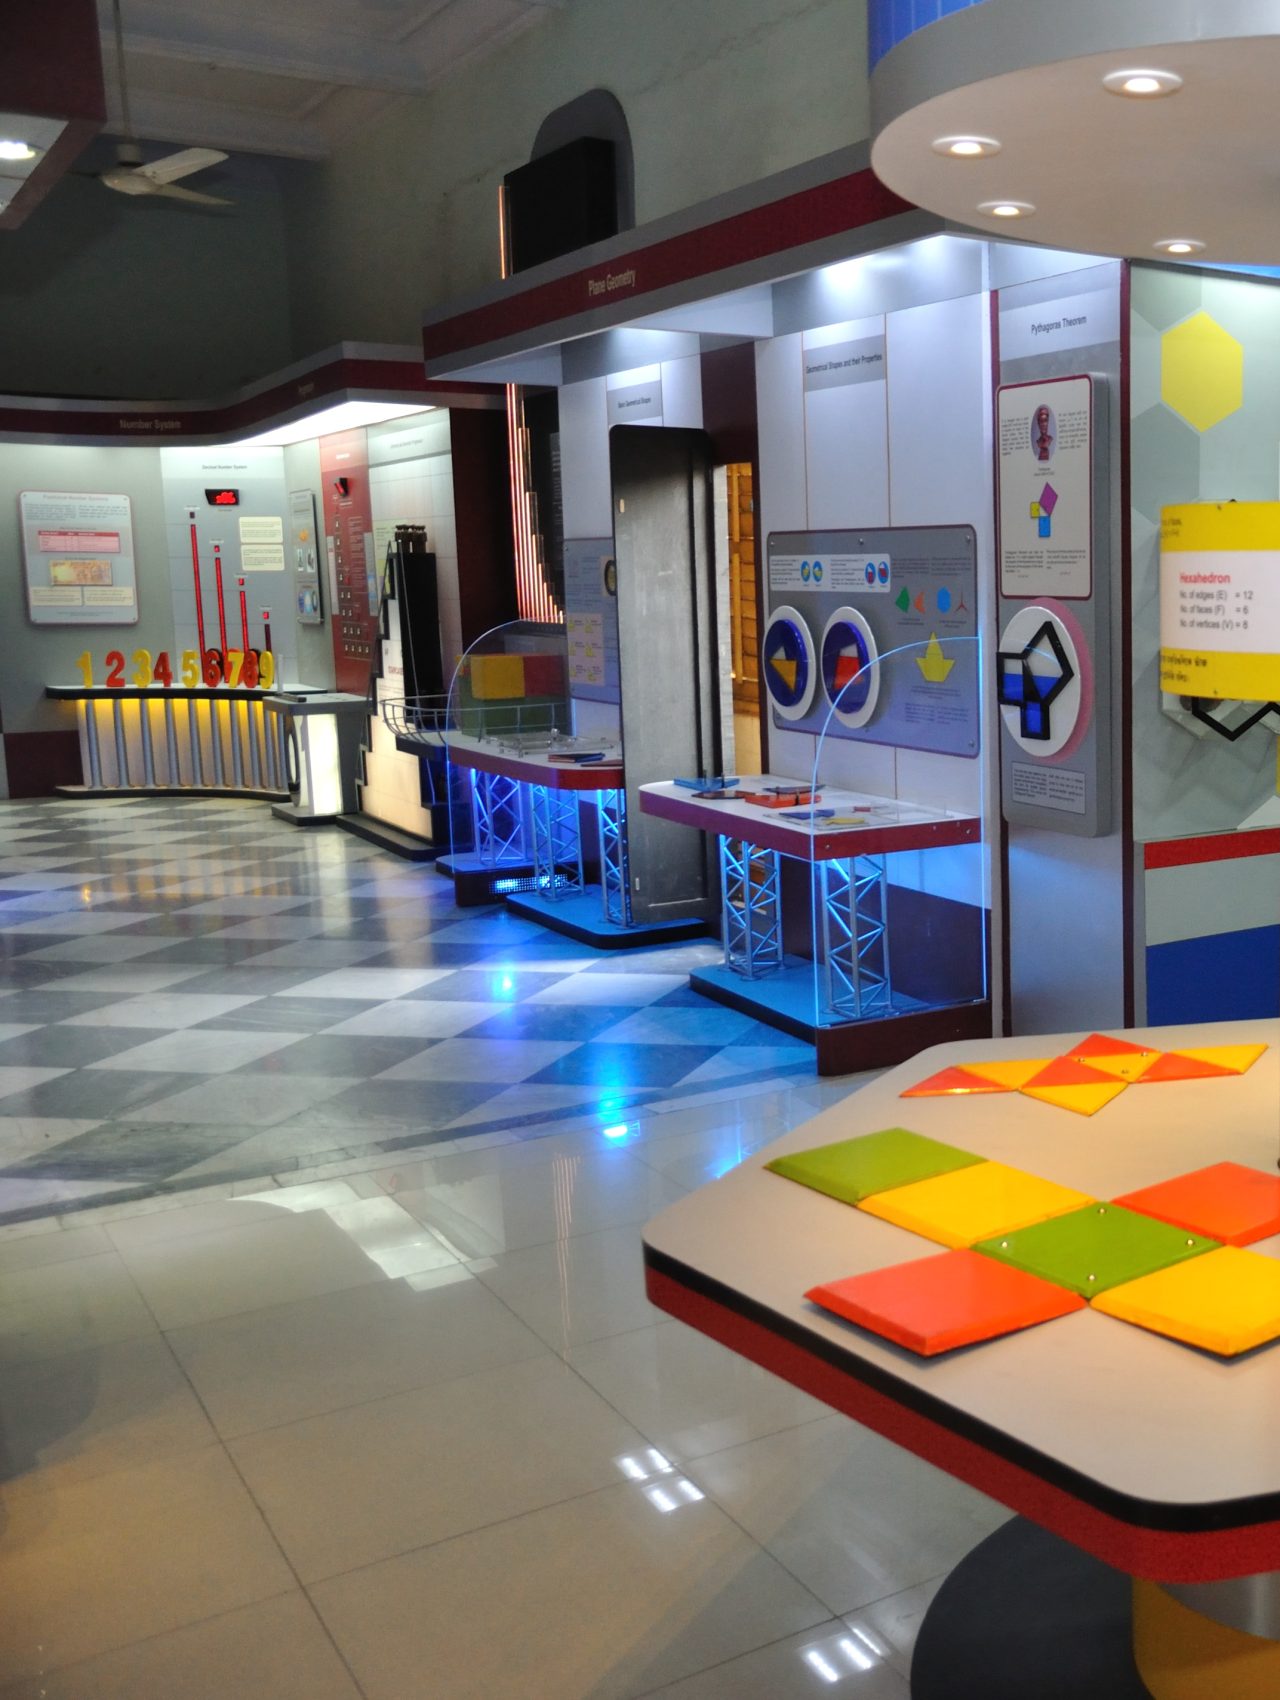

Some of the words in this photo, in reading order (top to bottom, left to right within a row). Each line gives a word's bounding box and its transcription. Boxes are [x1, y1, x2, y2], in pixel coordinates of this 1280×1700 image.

[1243, 590, 1254, 600] 12
[76, 650, 93, 689] 1
[105, 649, 126, 688] 2
[132, 648, 152, 688] 3
[153, 651, 173, 688] 4
[181, 649, 200, 689] 5
[204, 650, 221, 688] 6
[227, 651, 245, 689] 7
[260, 650, 275, 689] 9
